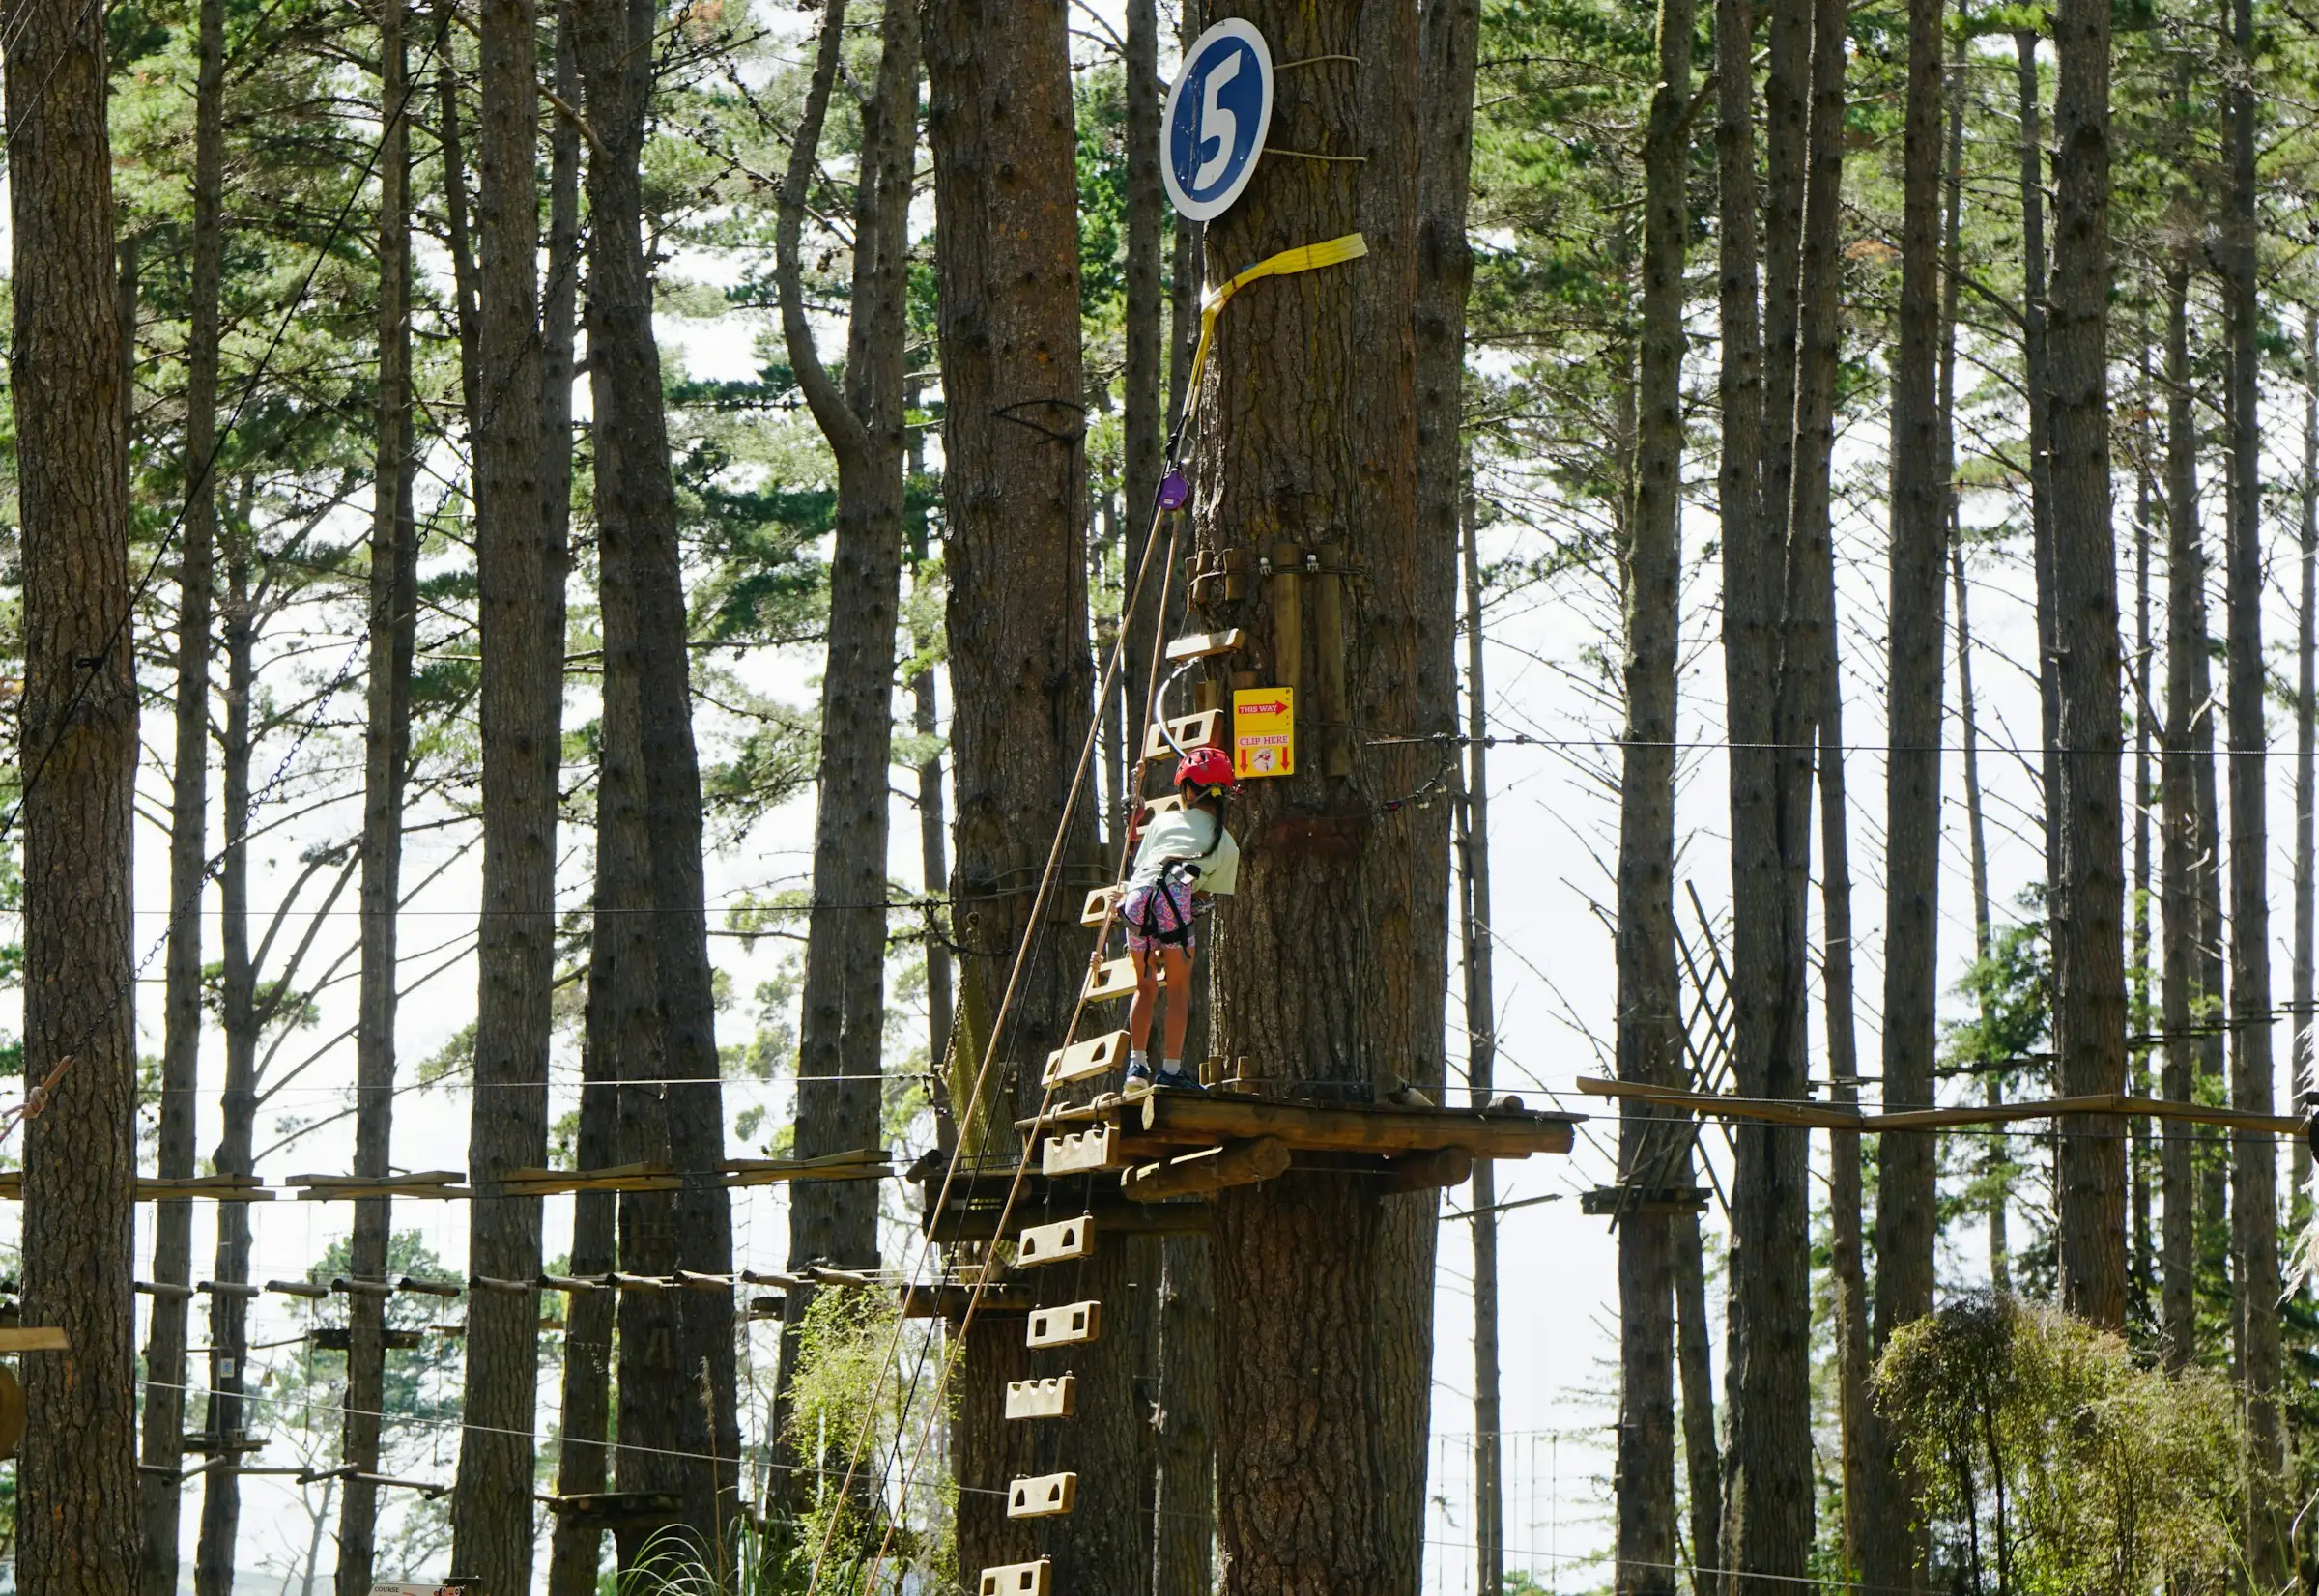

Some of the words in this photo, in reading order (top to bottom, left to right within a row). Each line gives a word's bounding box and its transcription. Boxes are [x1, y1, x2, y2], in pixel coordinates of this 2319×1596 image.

[1193, 49, 1241, 190] 5
[1240, 738, 1260, 746] CLIP
[1264, 736, 1288, 745] HERE
